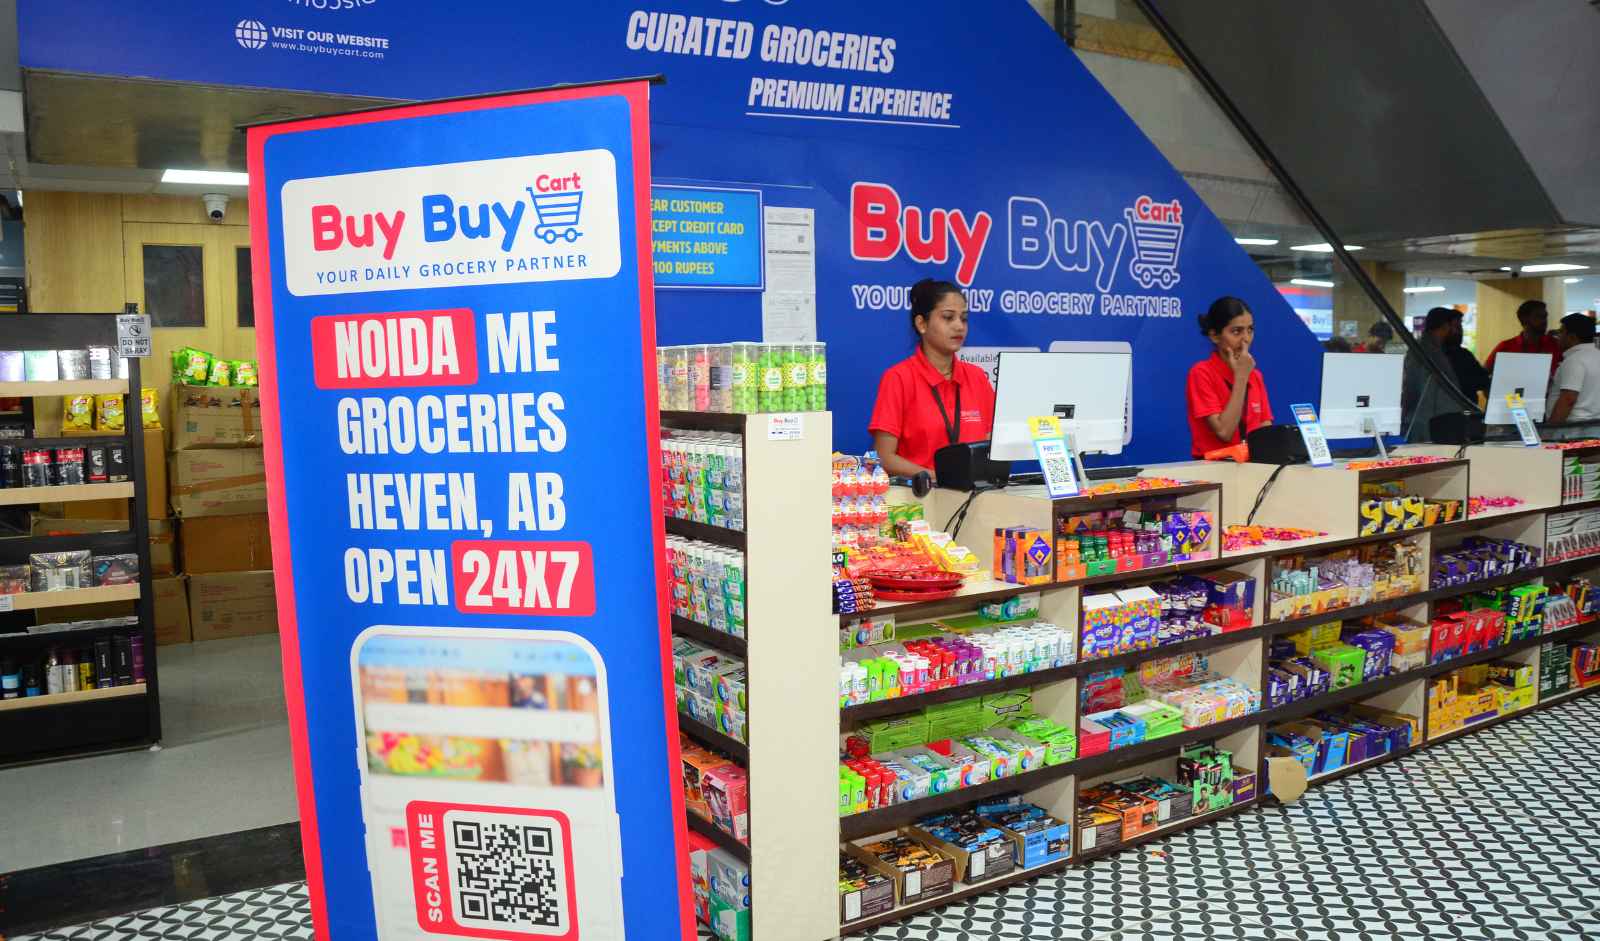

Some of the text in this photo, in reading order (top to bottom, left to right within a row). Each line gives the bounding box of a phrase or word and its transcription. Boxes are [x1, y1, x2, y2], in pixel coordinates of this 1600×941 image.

[272, 27, 389, 48] VISIT OUR WEBSITE
[272, 42, 384, 58] www.buybuycart.com
[626, 10, 896, 73] CURATED GROCERIES
[747, 77, 952, 120] PREMIUM EXPERIENCE
[535, 171, 581, 192] Cart
[671, 200, 724, 214] CUSTOMER
[1135, 195, 1183, 224] Cart
[311, 194, 525, 260] Buy Buy
[652, 220, 744, 235] CEPT CREDIT CARD
[850, 181, 1127, 292] Buy Buy
[652, 240, 728, 255] YMENTS ABOVE
[316, 254, 588, 284] YOUR DAILY GROCERY PARTNER
[654, 261, 714, 275] 100 RUPEES
[961, 289, 993, 312] ILY
[1000, 290, 1094, 314] GROCERY
[1100, 295, 1182, 317] PARTNER
[334, 310, 560, 379] NOIDA ME
[960, 352, 998, 363] Available
[337, 391, 567, 455] GROCERIES
[346, 472, 566, 538] HEVEN, AB
[344, 547, 580, 609] OPEN 24X7
[418, 813, 443, 922] SCAN ME
